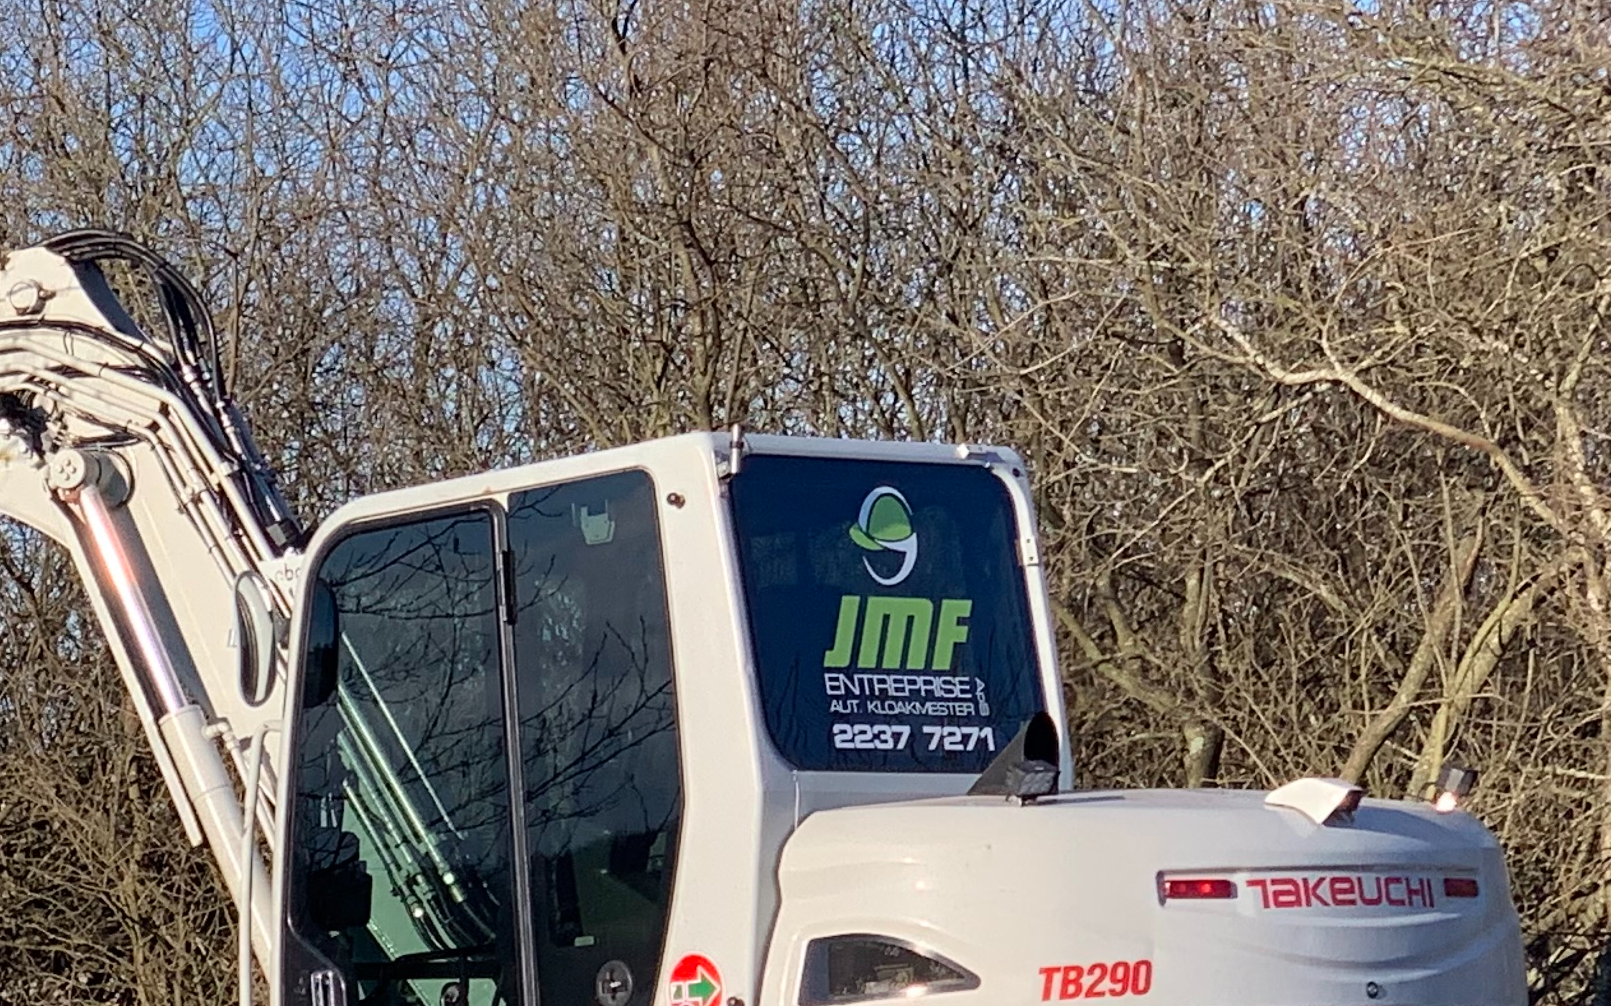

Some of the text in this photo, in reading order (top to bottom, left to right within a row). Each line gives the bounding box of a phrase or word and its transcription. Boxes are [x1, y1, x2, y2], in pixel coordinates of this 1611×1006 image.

[823, 595, 973, 671] JMF
[823, 673, 972, 699] ENTREPRISE
[867, 700, 975, 716] KLOAKMESTER
[832, 723, 996, 751] 2237 7271
[1038, 959, 1153, 1001] TB290
